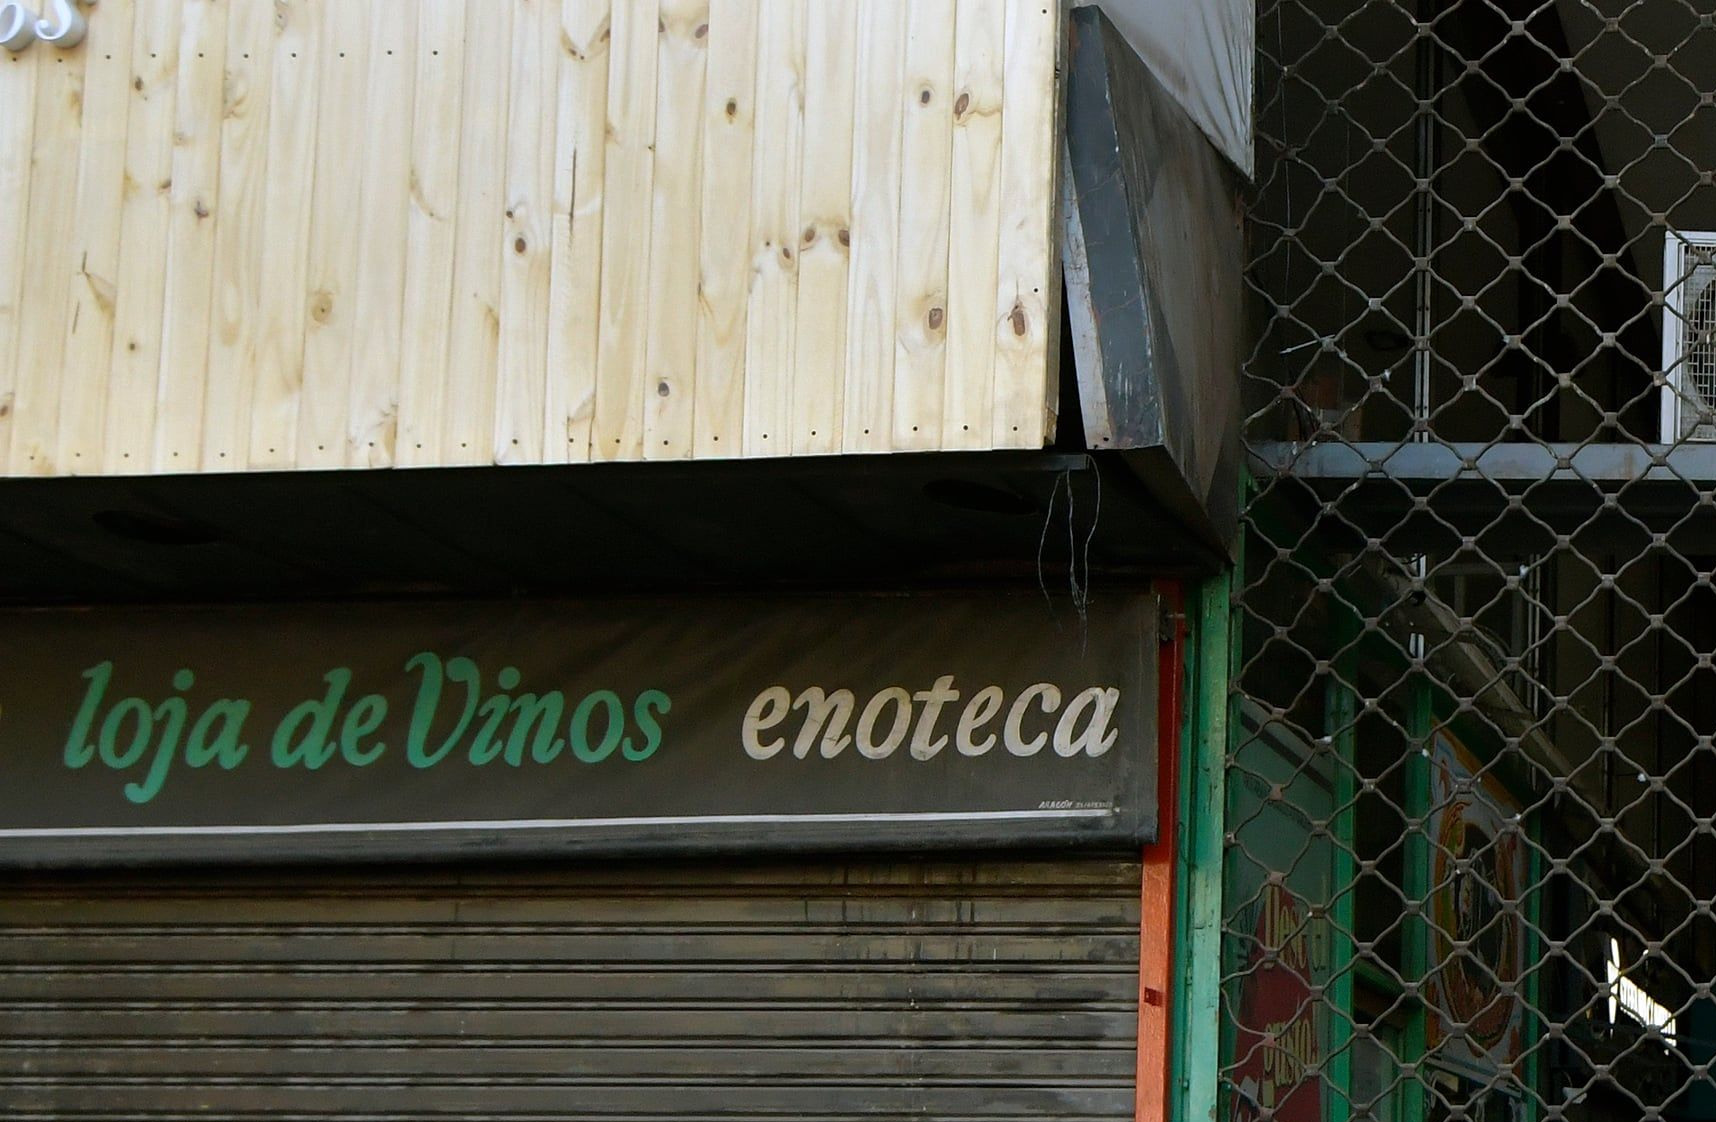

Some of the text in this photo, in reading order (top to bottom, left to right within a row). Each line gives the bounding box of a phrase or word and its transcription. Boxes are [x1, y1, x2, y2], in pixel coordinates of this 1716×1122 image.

[64, 652, 1120, 805] loja de Vinos enoteca
